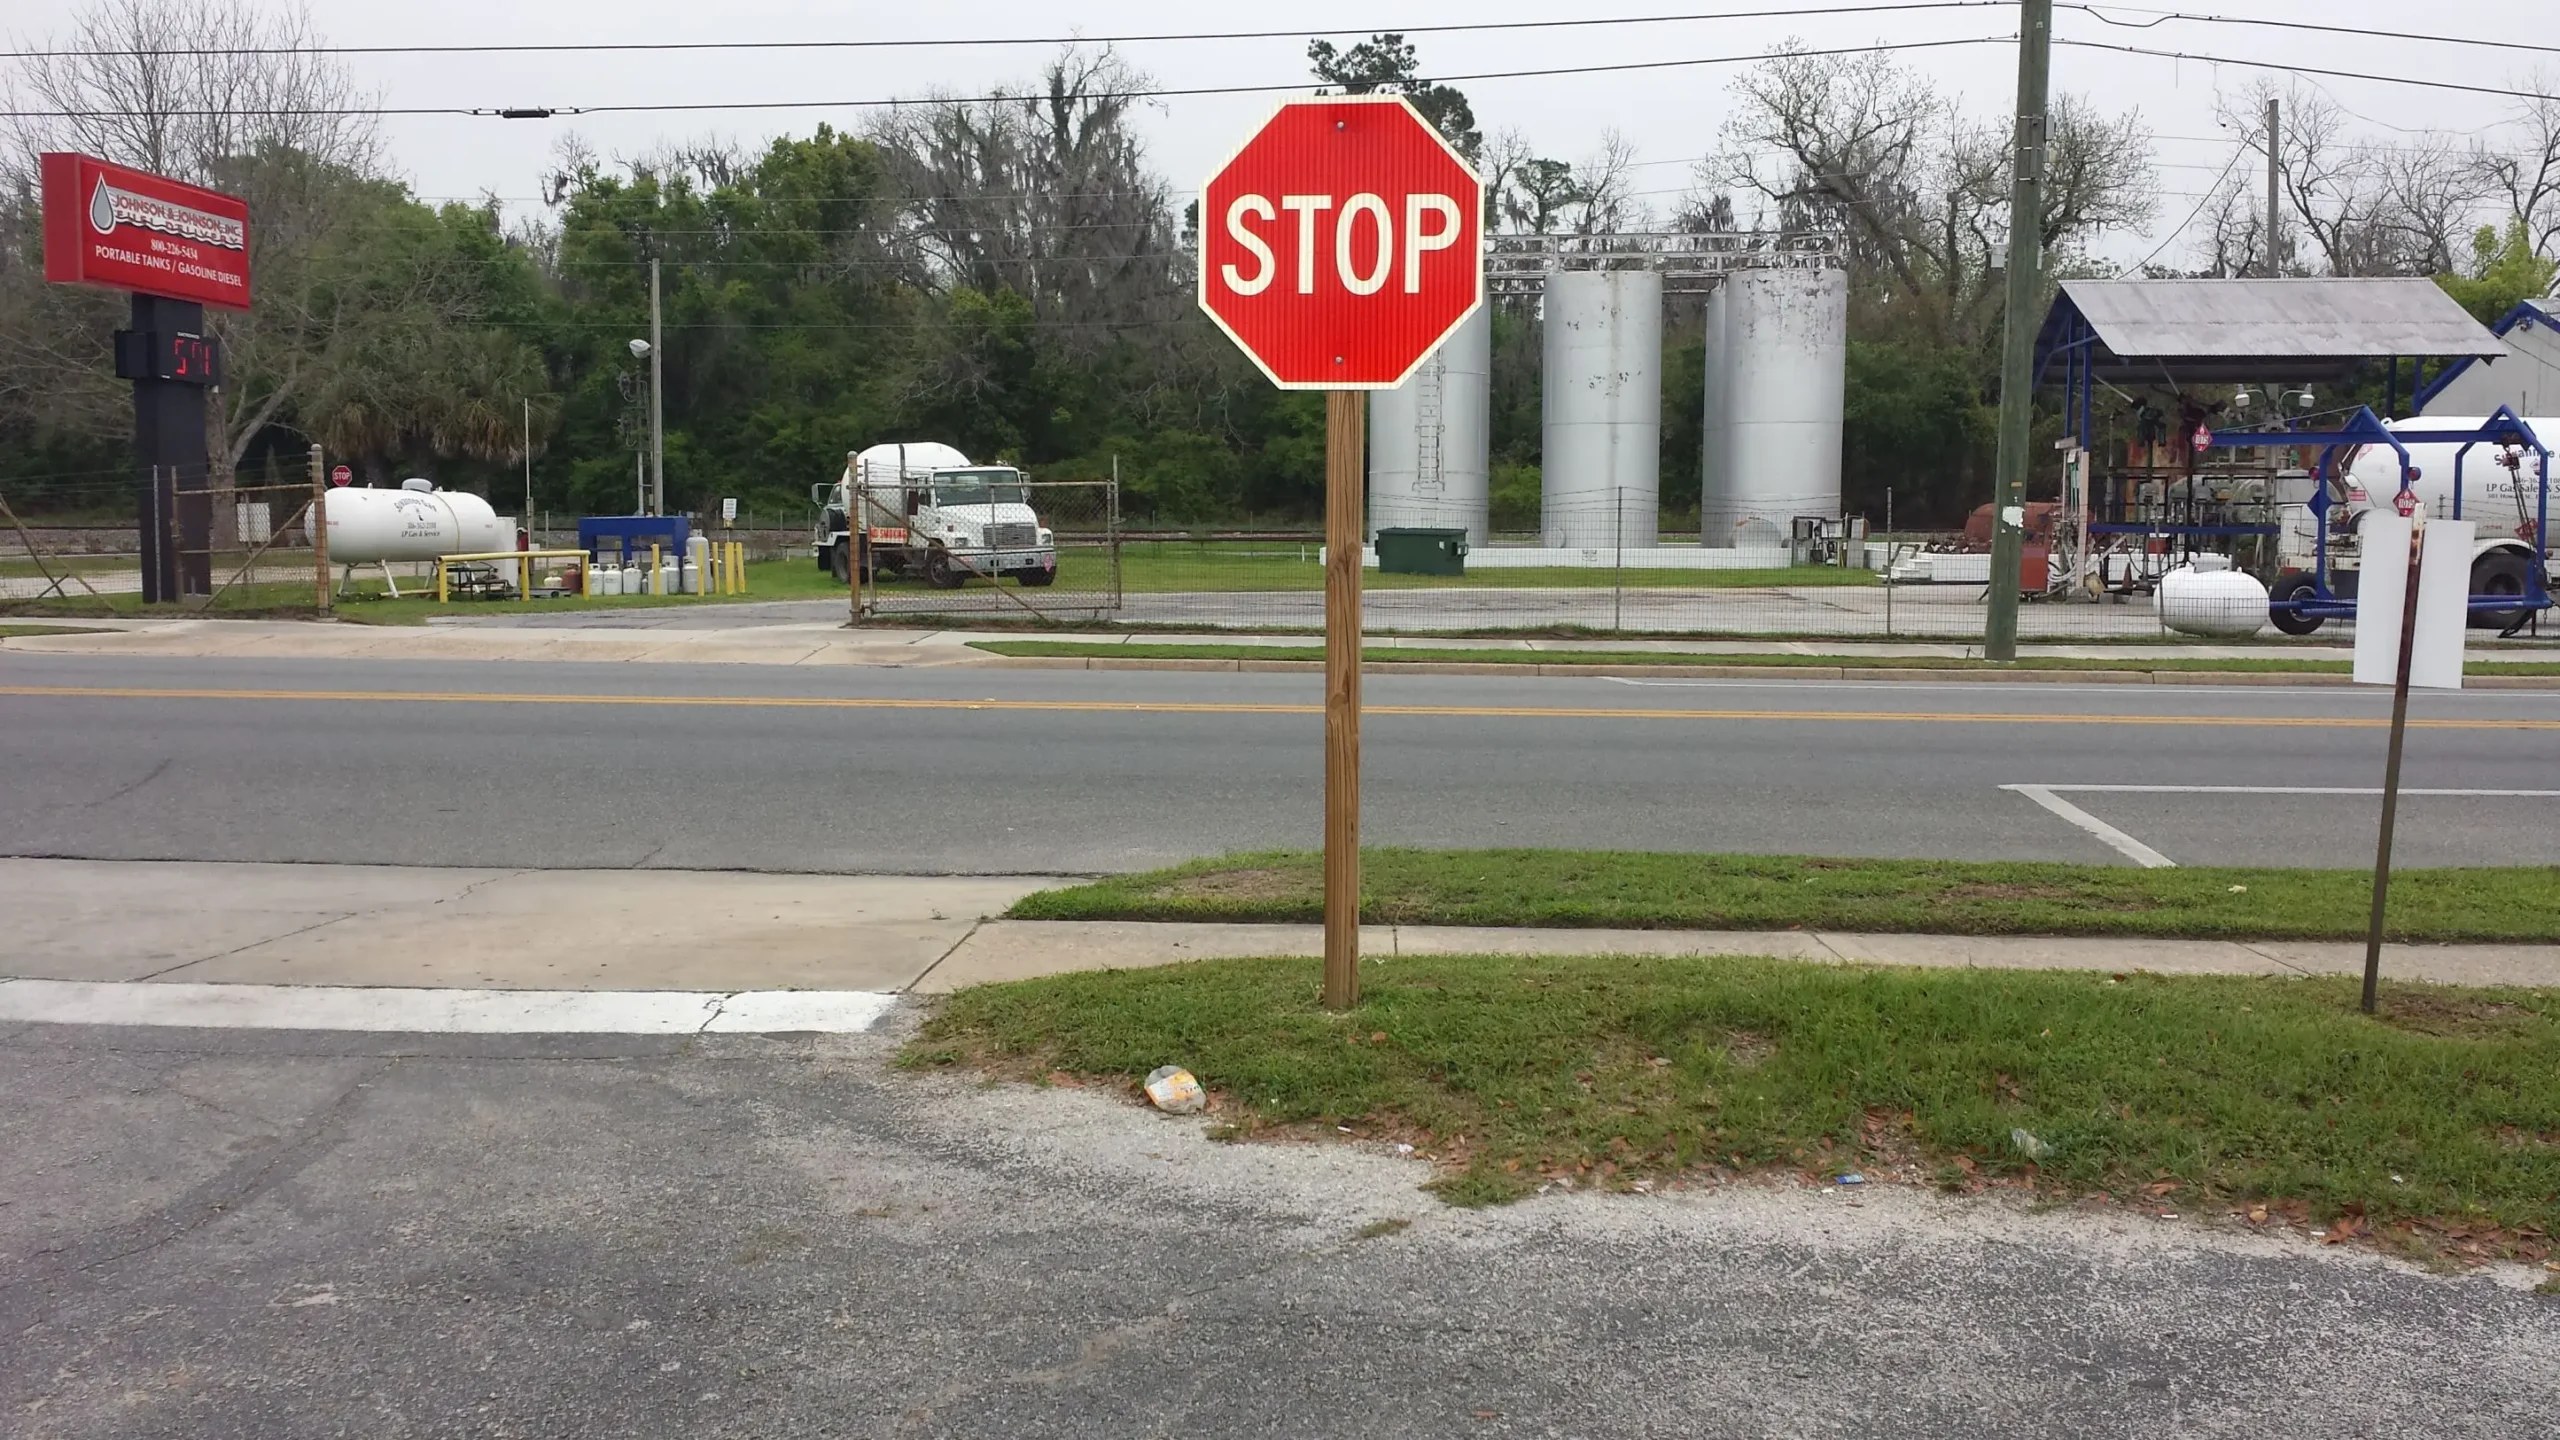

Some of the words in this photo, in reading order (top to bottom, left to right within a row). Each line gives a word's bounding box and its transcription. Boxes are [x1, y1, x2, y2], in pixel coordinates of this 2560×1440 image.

[114, 194, 165, 217] JOHNSON
[167, 207, 174, 220] &
[176, 209, 220, 231] JOHNSON
[1221, 192, 1461, 296] STOP
[95, 244, 141, 265] PORTABLE
[142, 254, 171, 271] TANKS
[178, 261, 218, 281] GASOLINE
[218, 271, 243, 287] DIESEL
[334, 471, 350, 480] STOP
[2486, 483, 2498, 492] LP
[879, 528, 907, 538] SMOKING
